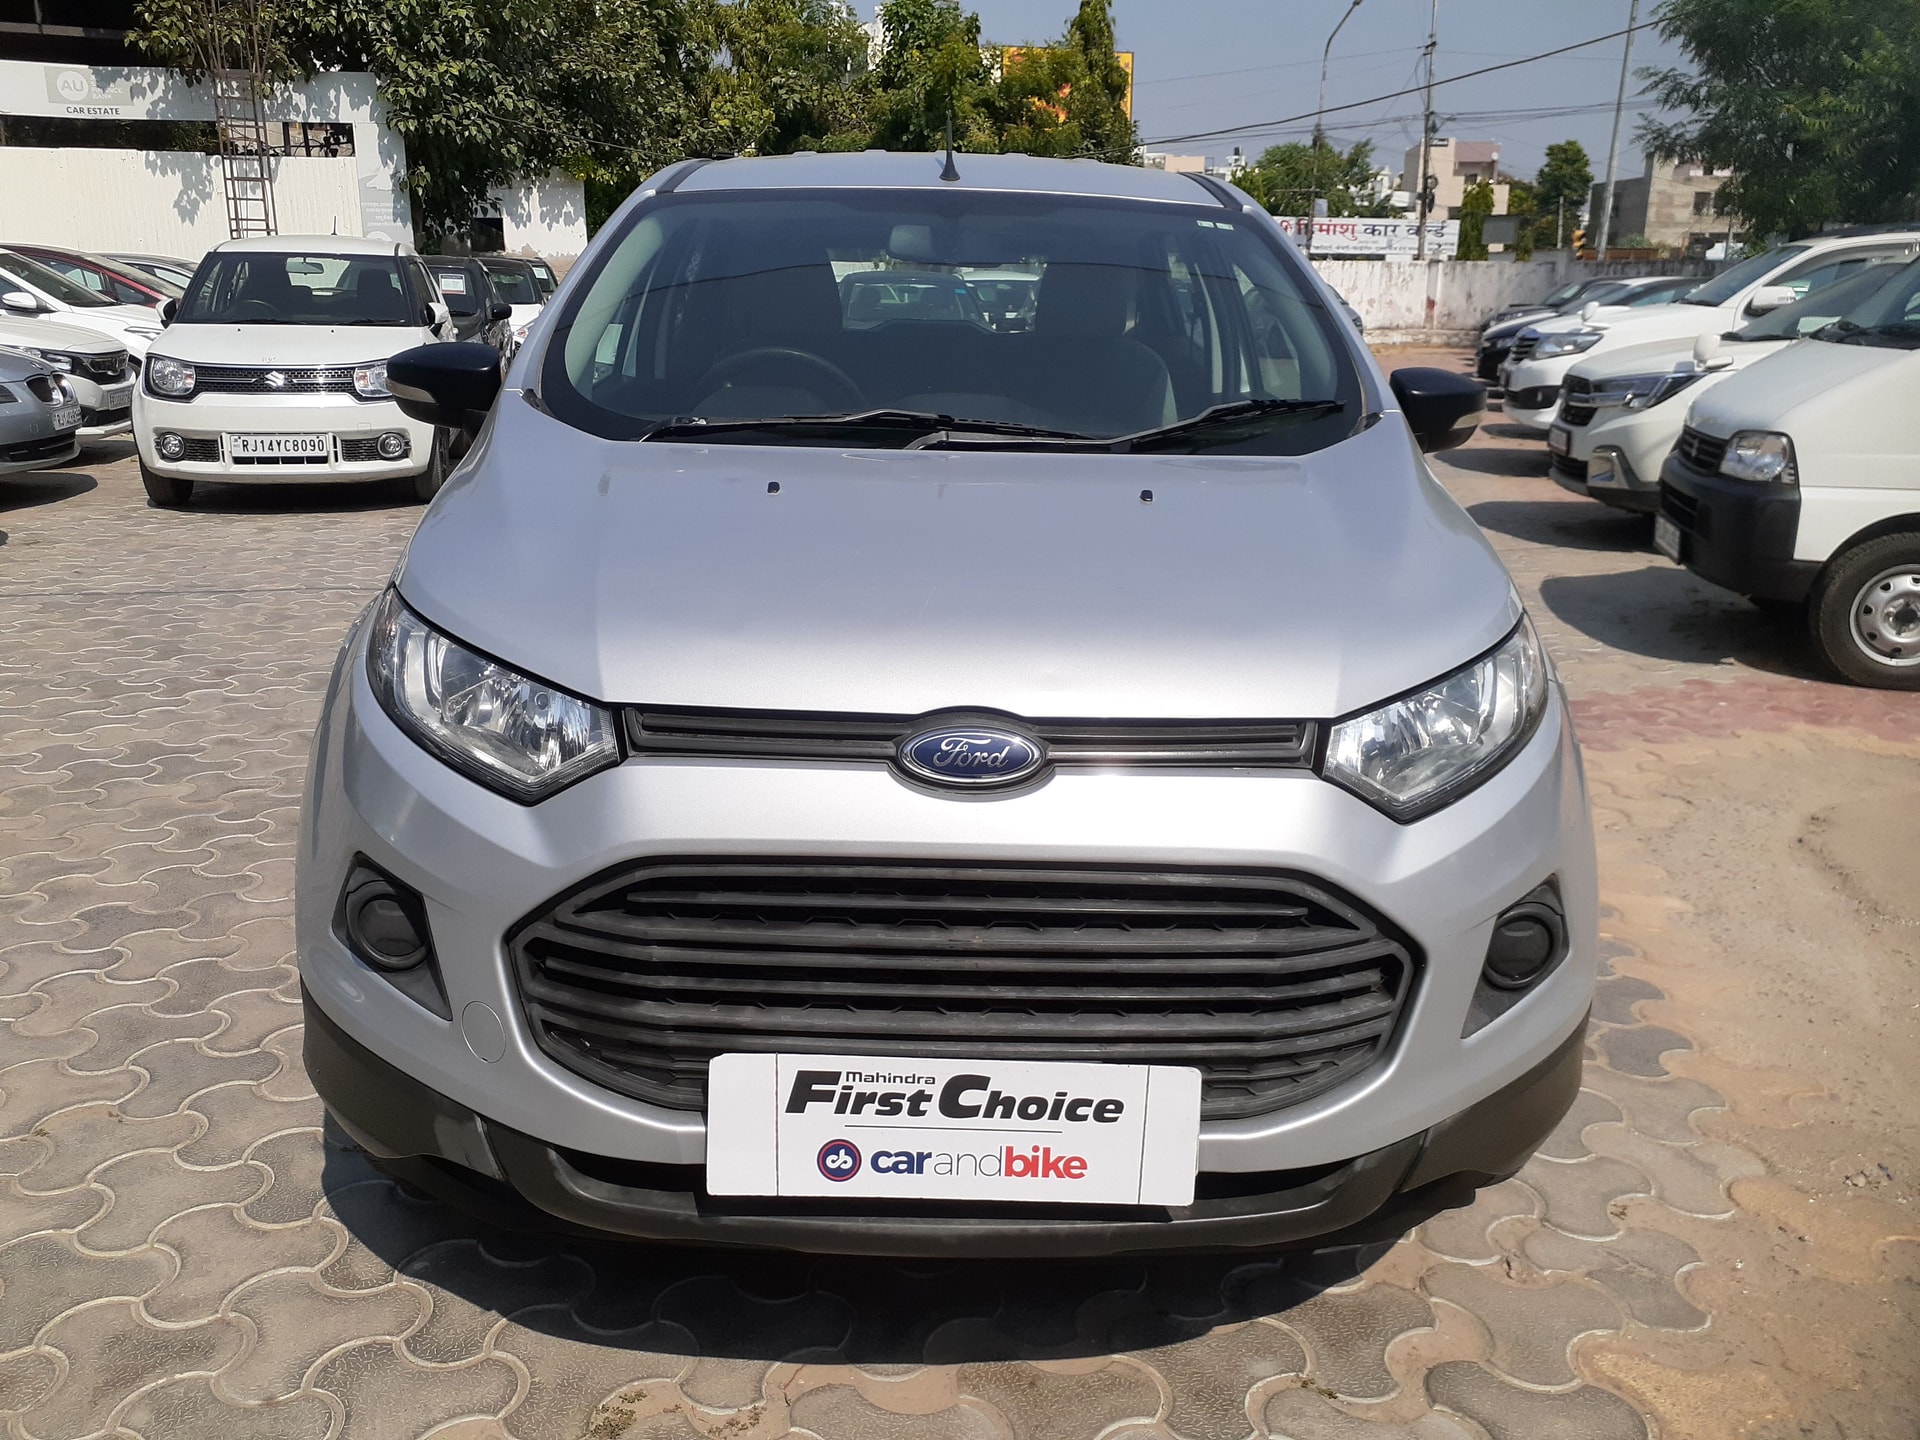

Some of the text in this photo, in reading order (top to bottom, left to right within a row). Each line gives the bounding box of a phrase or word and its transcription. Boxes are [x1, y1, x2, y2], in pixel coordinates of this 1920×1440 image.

[60, 79, 85, 92] AU
[66, 106, 121, 116] CAR ESTATE
[1362, 223, 1401, 238] कार
[241, 439, 325, 453] RJ14YC8090
[932, 737, 1011, 768] Ford
[845, 1071, 936, 1085] Mahindra
[869, 1144, 1088, 1180] carandbike
